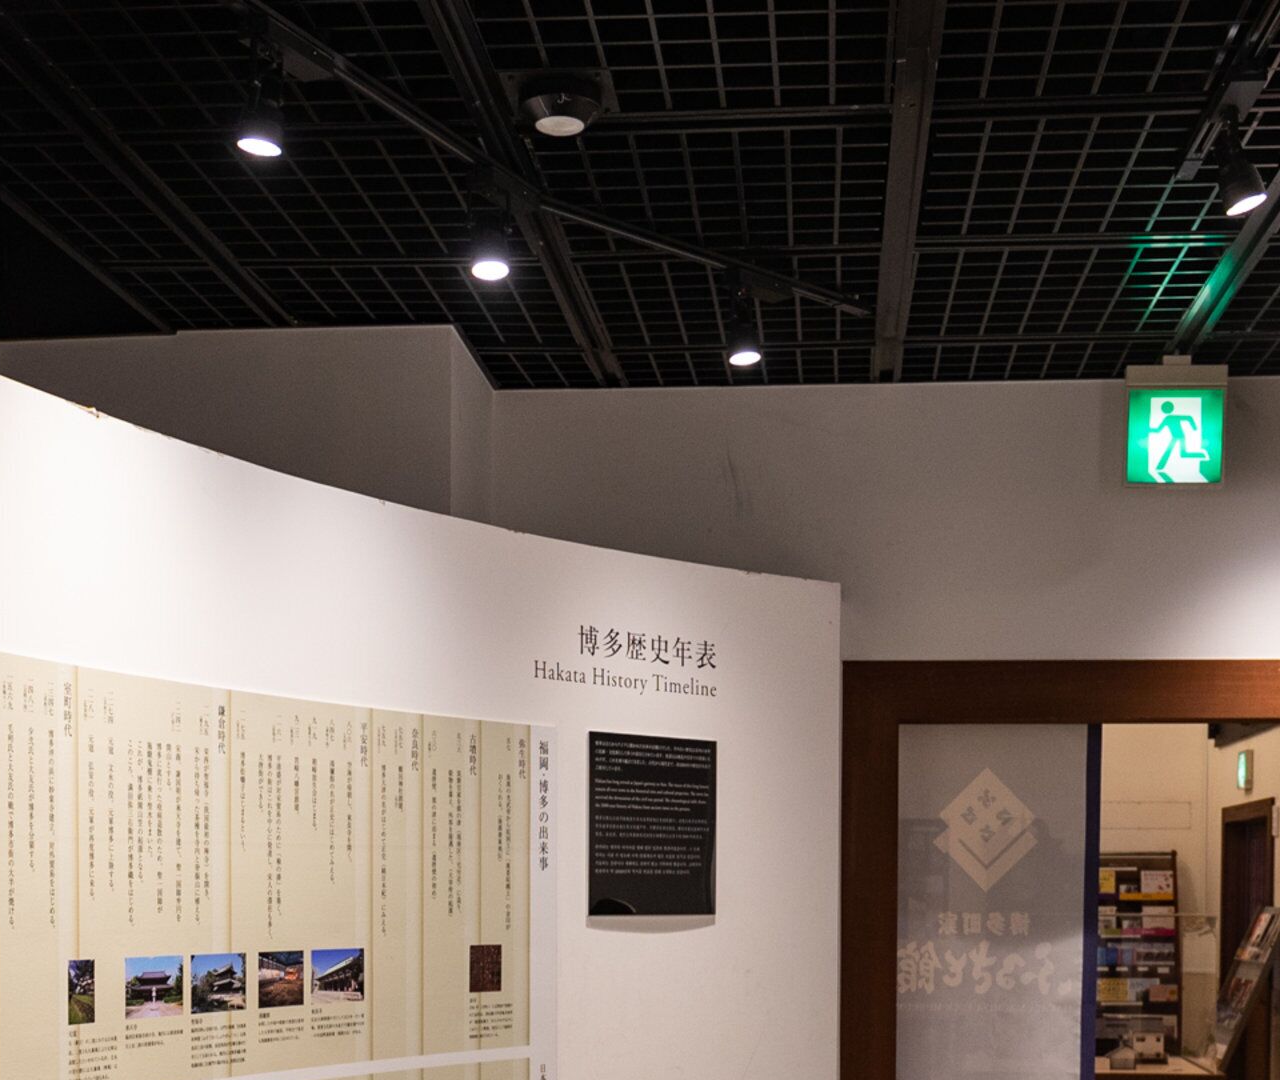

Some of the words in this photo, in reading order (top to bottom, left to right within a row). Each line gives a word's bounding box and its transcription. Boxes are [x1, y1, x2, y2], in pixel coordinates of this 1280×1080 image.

[578, 625, 717, 670] 博多歴史年表
[534, 659, 587, 685] Hakata
[592, 666, 648, 696] History
[651, 673, 718, 698] Timeline
